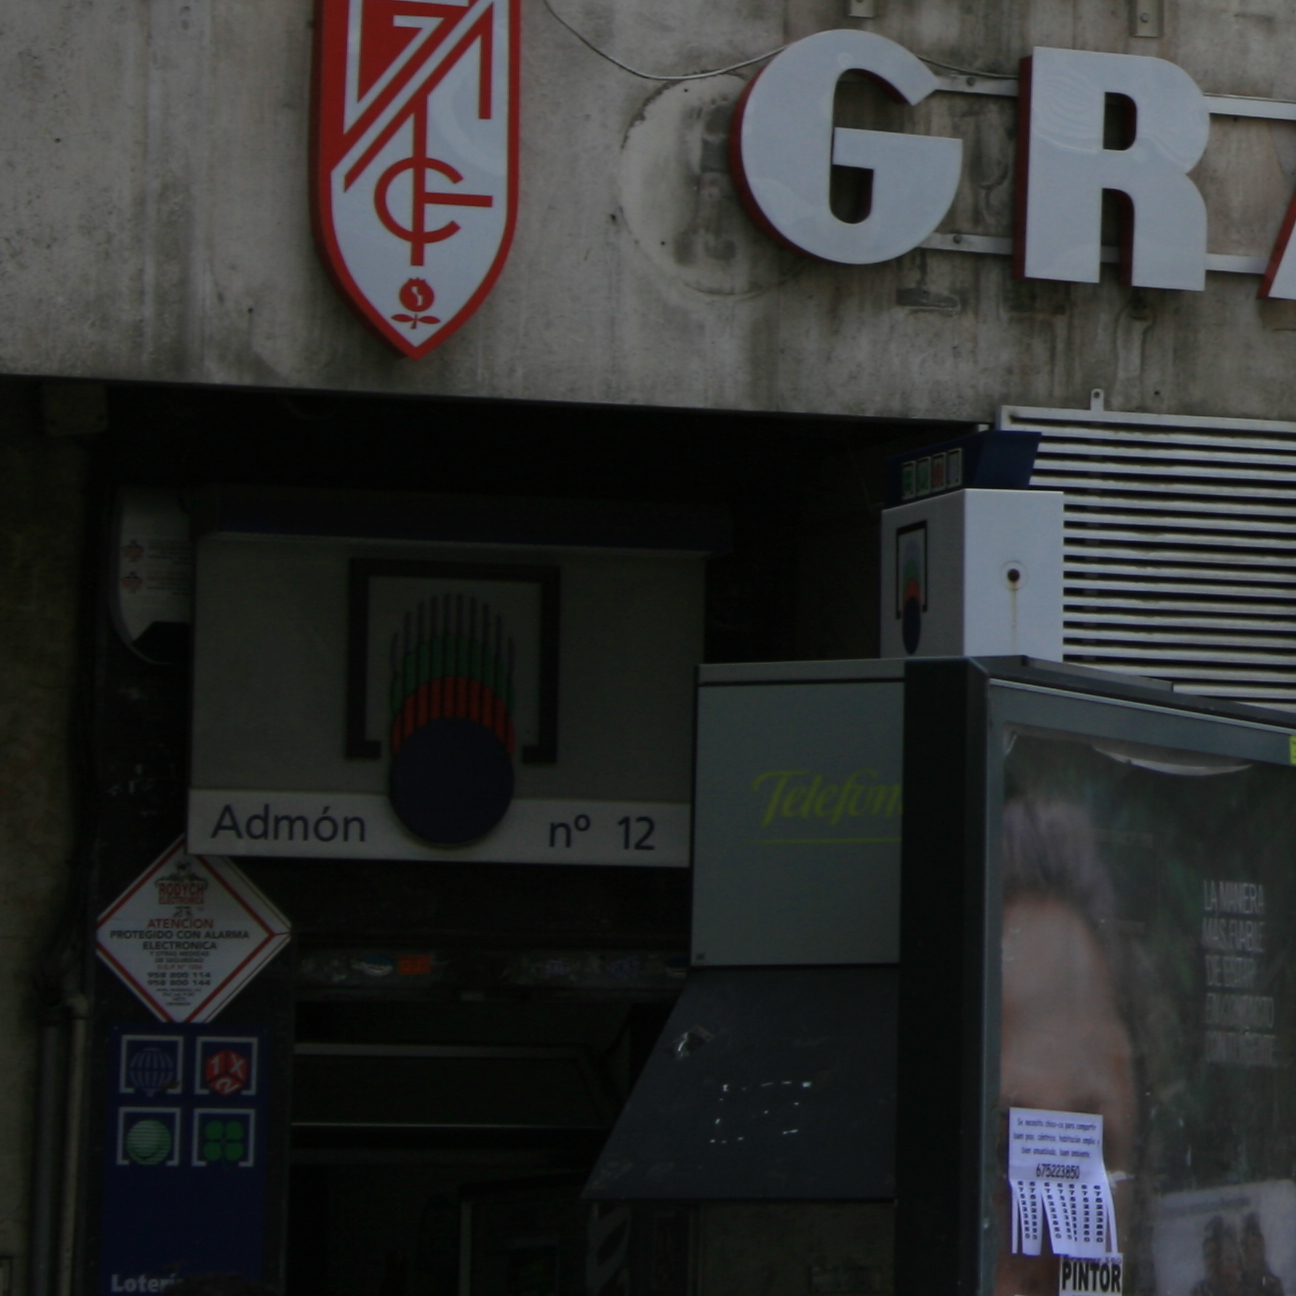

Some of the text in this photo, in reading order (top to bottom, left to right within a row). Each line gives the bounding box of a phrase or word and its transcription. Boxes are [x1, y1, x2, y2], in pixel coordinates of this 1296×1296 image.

[211, 802, 367, 846] Admón
[617, 816, 656, 851] 12
[147, 918, 214, 929] ATENCION
[110, 930, 250, 940] PROTEGIDO CON ALARMA
[143, 941, 217, 950] ELECTRONICA
[1036, 1163, 1080, 1179] 675223850
[1062, 1260, 1121, 1293] PINTOR
